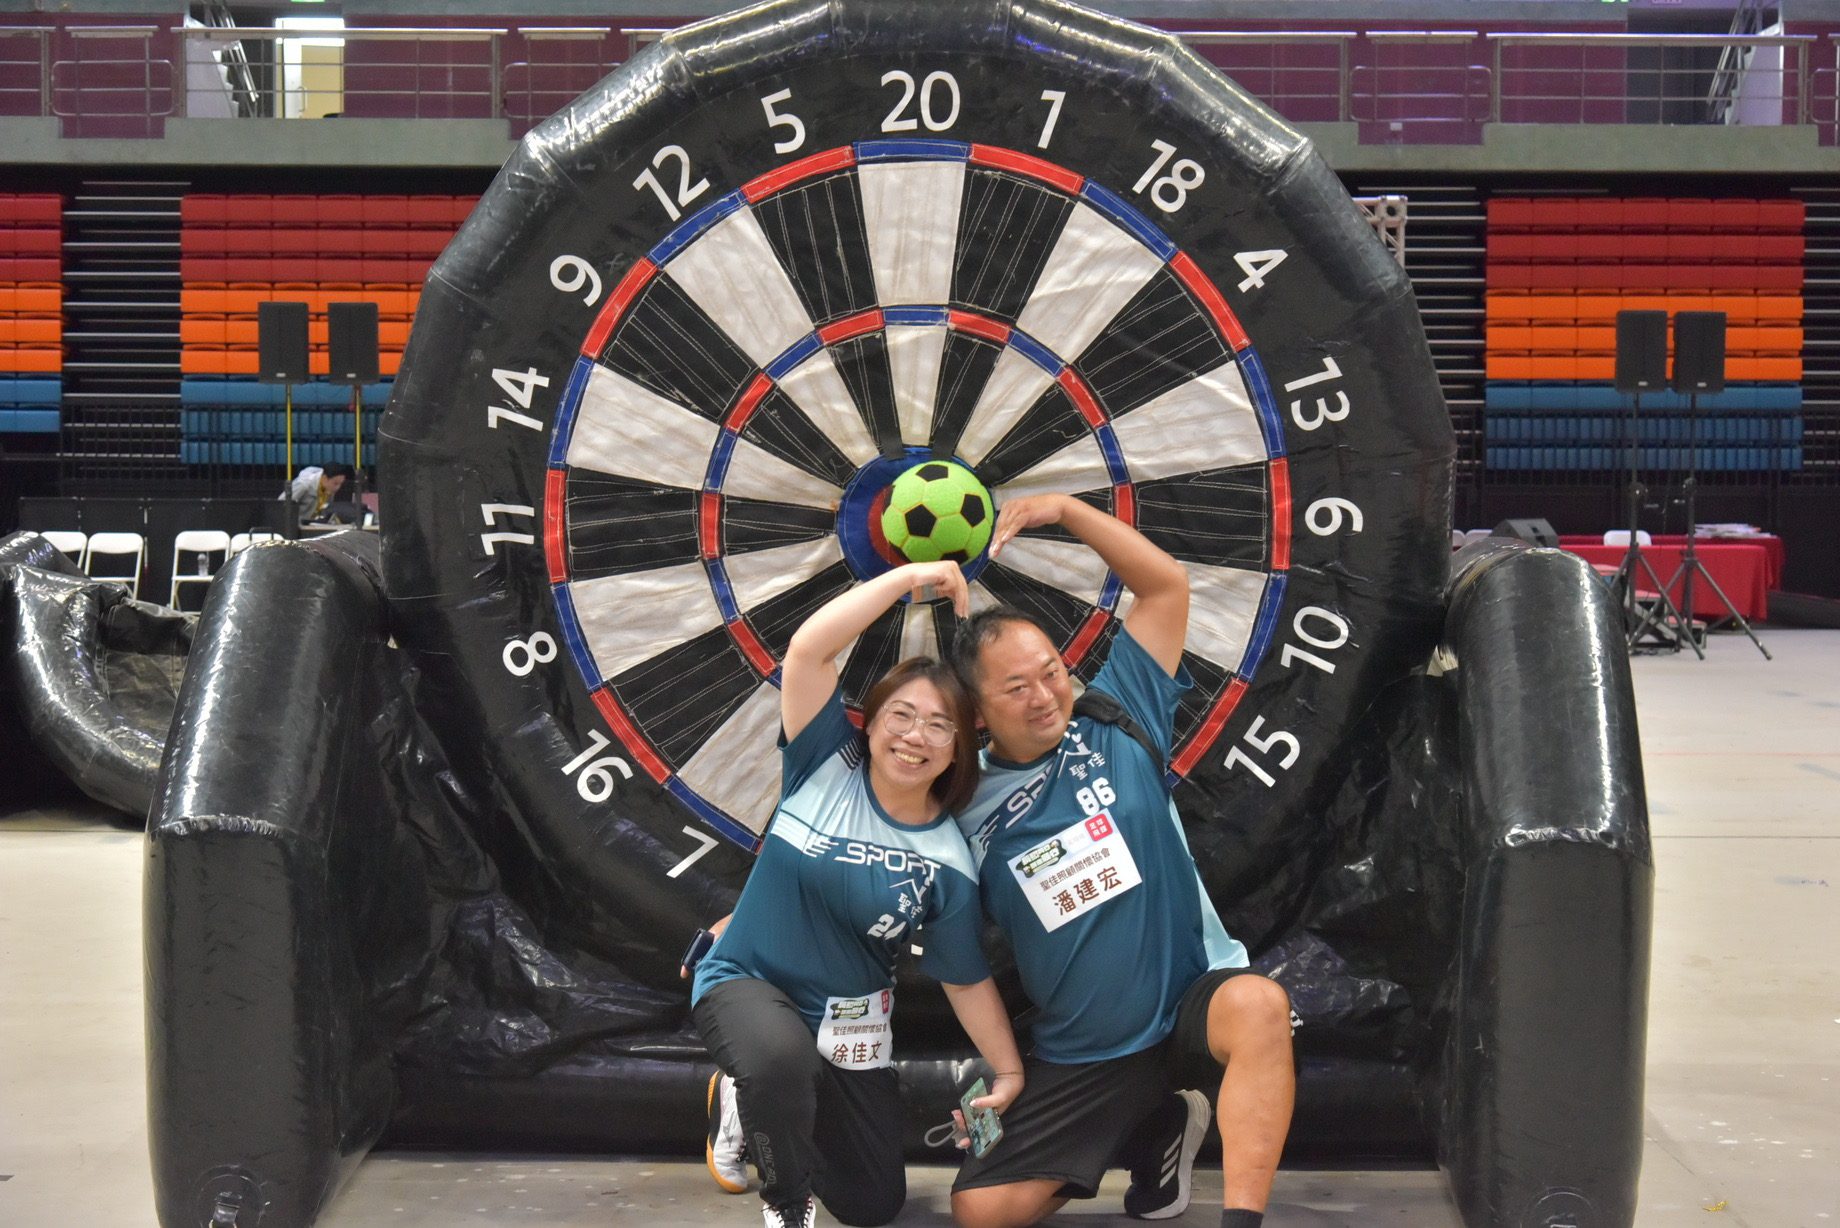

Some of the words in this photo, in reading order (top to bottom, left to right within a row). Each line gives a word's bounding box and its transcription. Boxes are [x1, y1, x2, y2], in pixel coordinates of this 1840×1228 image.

[760, 87, 806, 154] 5
[880, 69, 961, 133] 20
[1037, 89, 1066, 149] 1
[632, 144, 711, 222] 12
[1132, 138, 1206, 213] 18
[549, 254, 602, 307] 9
[1233, 249, 1289, 293] 4
[487, 366, 550, 432] 14
[1284, 356, 1351, 431] 13
[480, 503, 535, 556] 11
[502, 631, 558, 677] 8
[1280, 606, 1350, 675] 10
[560, 728, 634, 803] 16
[1068, 751, 1106, 781] 聖佳
[1223, 714, 1301, 788] 15
[1076, 776, 1117, 816] 86
[666, 825, 719, 879] 7
[833, 842, 942, 882] SPORT
[1051, 866, 1123, 916] 潘建宏
[831, 1040, 883, 1064] 徐佳文
